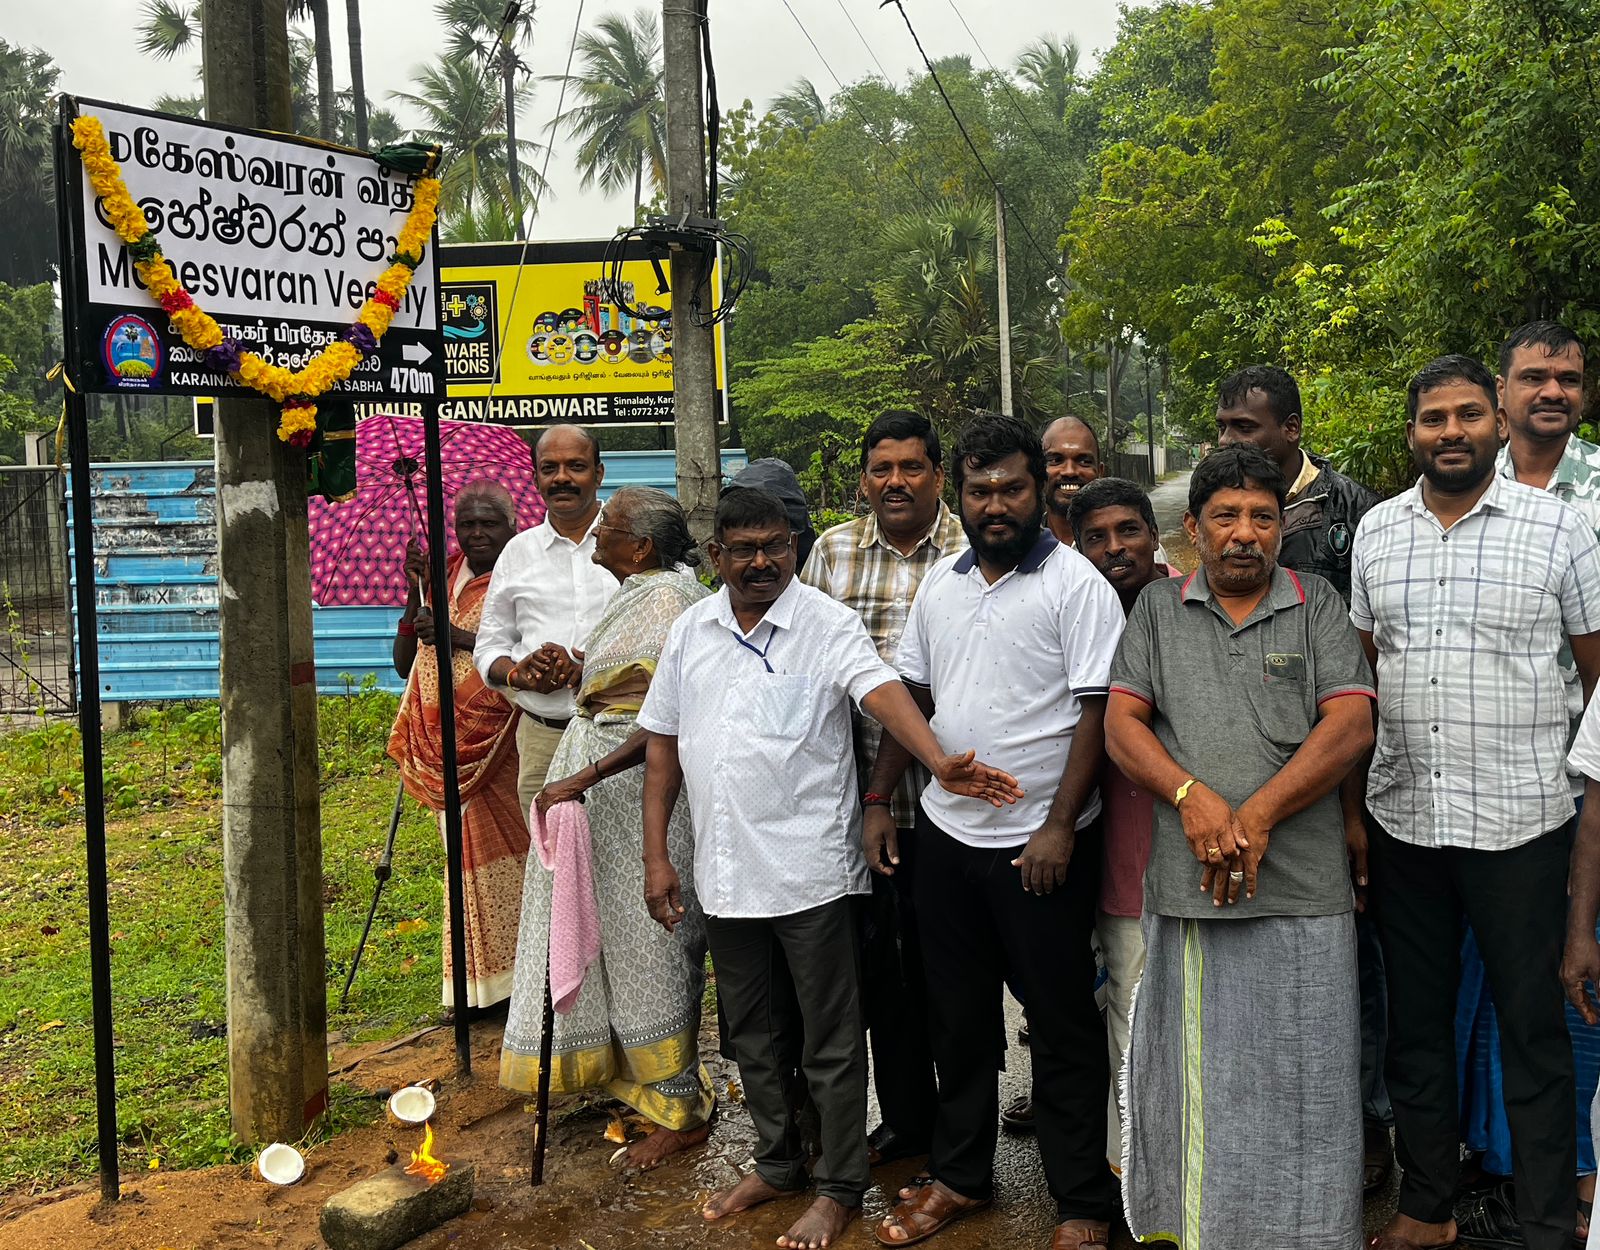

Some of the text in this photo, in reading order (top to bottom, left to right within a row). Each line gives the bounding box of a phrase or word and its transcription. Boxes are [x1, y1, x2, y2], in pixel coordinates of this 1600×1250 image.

[444, 342, 490, 358] WARE
[444, 358, 490, 375] TIONS
[344, 380, 384, 393] SABHA
[390, 367, 435, 394] 470m
[489, 397, 609, 418] HARDWARE
[614, 396, 656, 407] Sinnalady,
[631, 408, 652, 416] 0772
[654, 407, 669, 416] 247
